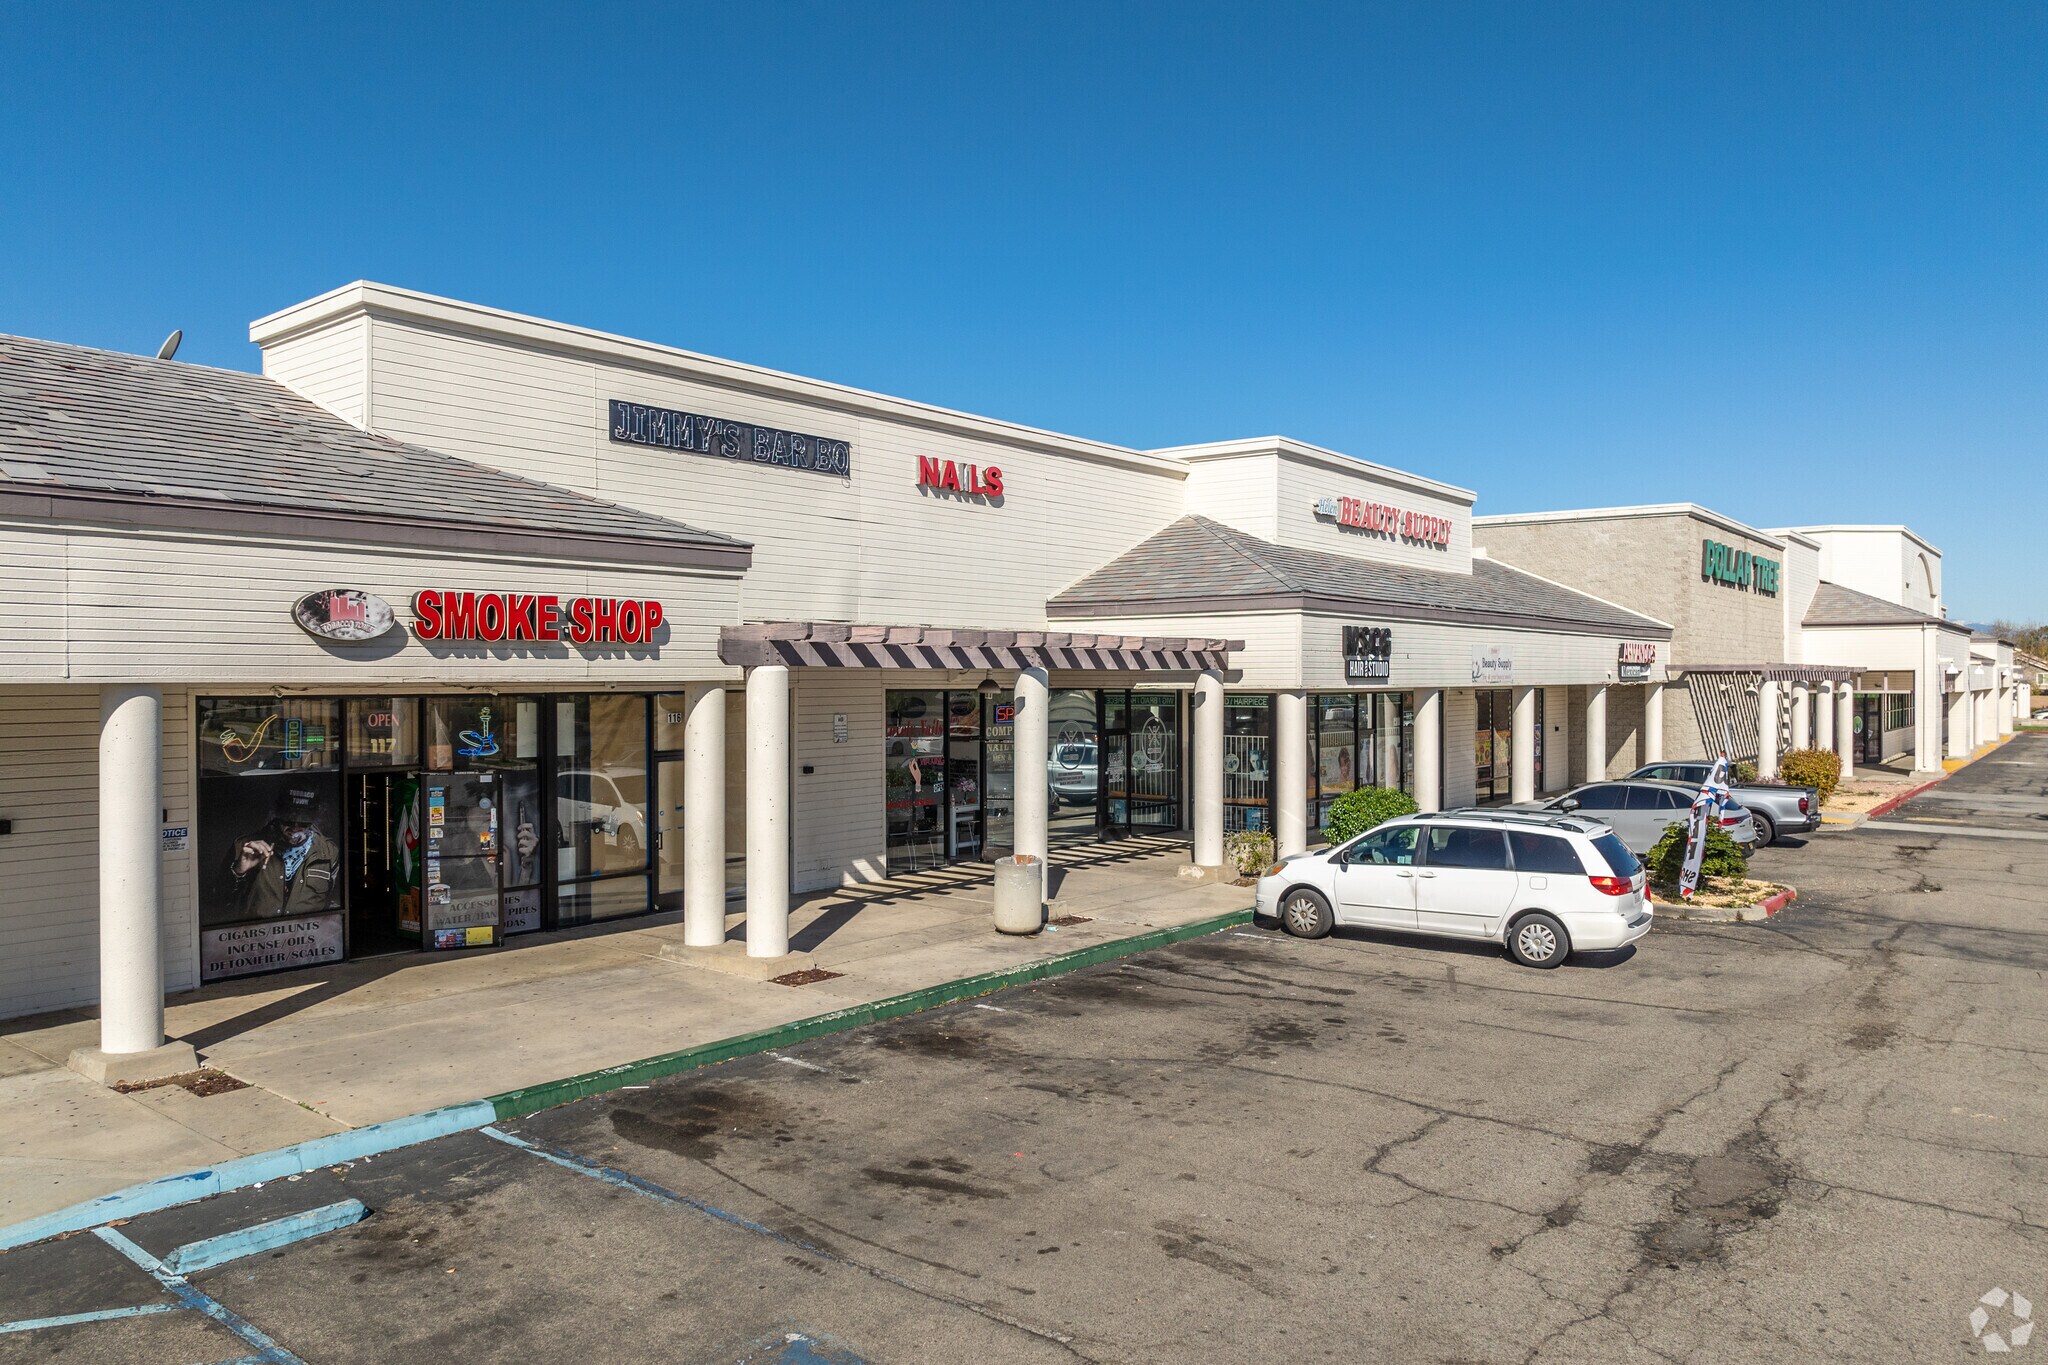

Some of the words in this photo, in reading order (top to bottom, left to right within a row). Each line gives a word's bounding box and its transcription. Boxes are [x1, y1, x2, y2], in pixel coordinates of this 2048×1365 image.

[614, 402, 740, 458] JIMMY'S
[753, 427, 809, 468] BAR
[917, 454, 1004, 497] NAILS
[1339, 496, 1401, 535] BEAUTY
[1402, 510, 1452, 545] SUPPLY
[1703, 538, 1751, 587] DOLLAR
[1754, 555, 1780, 593] TREE
[413, 589, 560, 642] SMOKE
[568, 597, 664, 644] SHOP
[1349, 660, 1364, 677] HAIR
[1368, 660, 1389, 677] STUDIO
[1481, 656, 1497, 671] Beauty
[1497, 656, 1512, 671] Supply
[1233, 697, 1268, 706] HAIRPIECE
[367, 713, 400, 727] OPEN
[668, 713, 682, 723] 116
[288, 720, 300, 758] OPEN
[370, 738, 397, 754] 117
[508, 905, 538, 916] PIPES
[218, 921, 320, 942] CIGARS/BLUNTS
[227, 934, 316, 955] INCENSE/OILS
[210, 945, 336, 972] DETOXIFIER/SCALES
